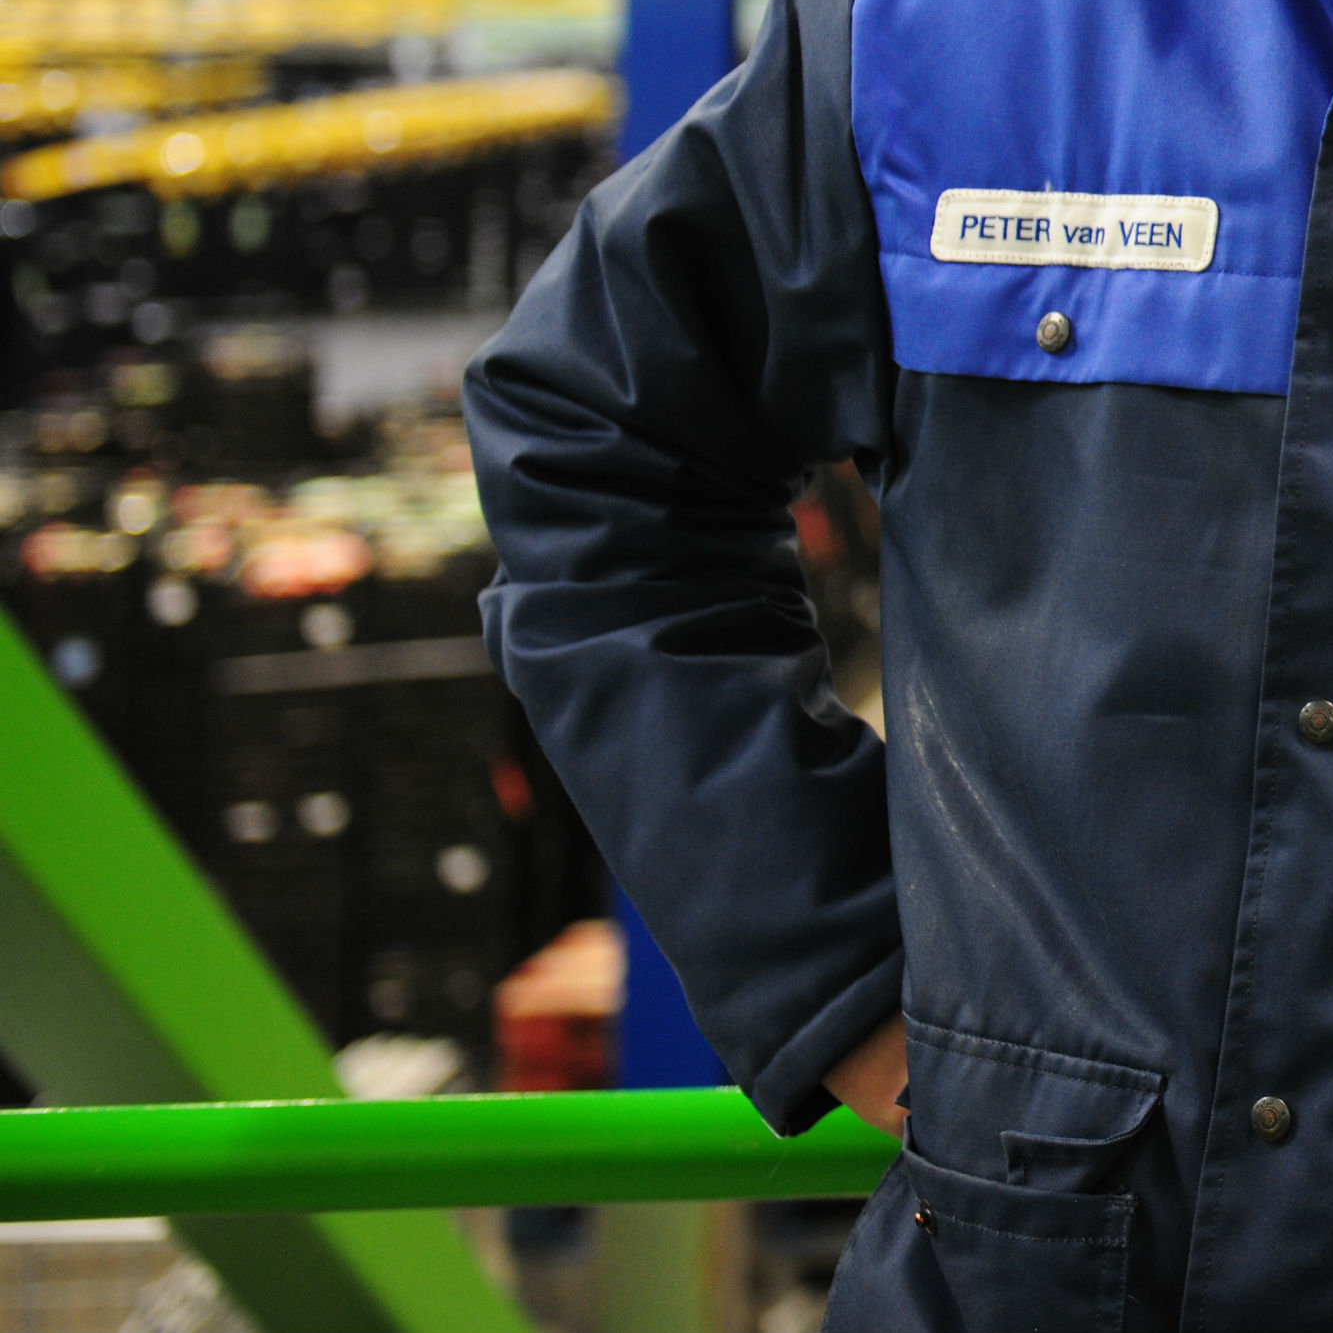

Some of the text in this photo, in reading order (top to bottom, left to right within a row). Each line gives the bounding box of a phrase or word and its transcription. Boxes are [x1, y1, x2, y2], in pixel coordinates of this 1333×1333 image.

[960, 215, 1183, 249] PETER van VEEN
